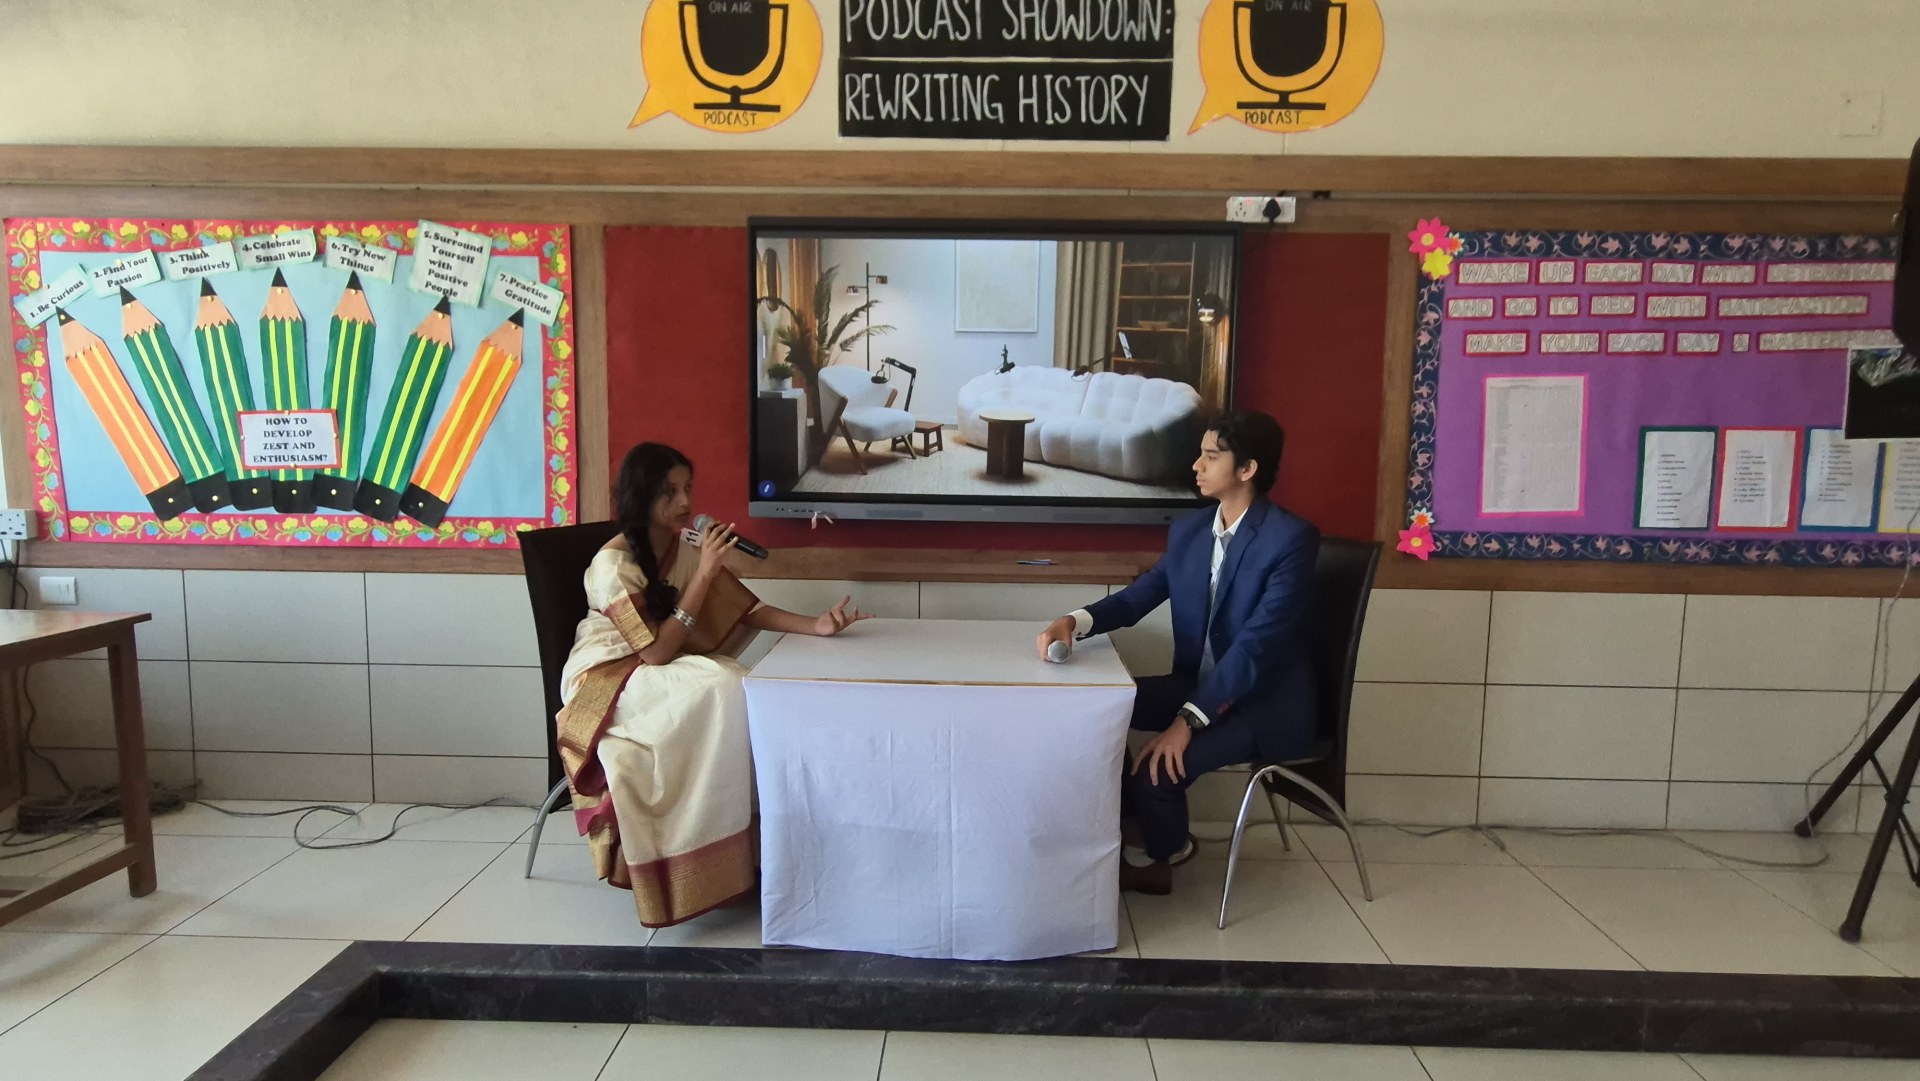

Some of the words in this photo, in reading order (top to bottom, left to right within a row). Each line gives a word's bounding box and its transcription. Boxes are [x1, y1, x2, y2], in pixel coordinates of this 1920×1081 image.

[731, 1, 752, 14] AIR
[1001, 0, 1172, 42] SHOWDOWN:
[845, 73, 1004, 123] REWRITING
[1018, 74, 1148, 126] HISTORY
[703, 111, 758, 126] PODCAST
[1244, 110, 1301, 126] PODCAST
[255, 253, 286, 263] Small
[288, 250, 311, 258] Wins
[363, 248, 386, 262] New
[432, 244, 475, 264] Yourself
[129, 256, 149, 269] Your
[182, 260, 231, 275] Positively
[340, 256, 375, 273] Things
[429, 259, 453, 271] with
[106, 272, 143, 288] Passion
[427, 268, 469, 288] Positive
[1461, 263, 1528, 283] WAKE
[1542, 262, 1573, 281] UP
[1588, 263, 1642, 282] EACH
[1653, 264, 1694, 282] DAY
[51, 280, 84, 305] Curious
[425, 280, 458, 298] People
[504, 289, 552, 316] Gratitude
[1450, 299, 1492, 317] AND
[1506, 298, 1536, 315] GO
[1552, 297, 1578, 314] TO
[1593, 296, 1635, 314] BED
[1469, 334, 1525, 352] MAKE
[1543, 333, 1598, 352] YOUR
[1610, 333, 1664, 352] EACH
[1680, 334, 1718, 351] DAY
[265, 418, 291, 426] HOW
[263, 430, 312, 438] DEVELOP
[263, 442, 289, 450] ZEST
[292, 442, 315, 450] AND
[253, 454, 328, 463] ENTHUSIASM?
